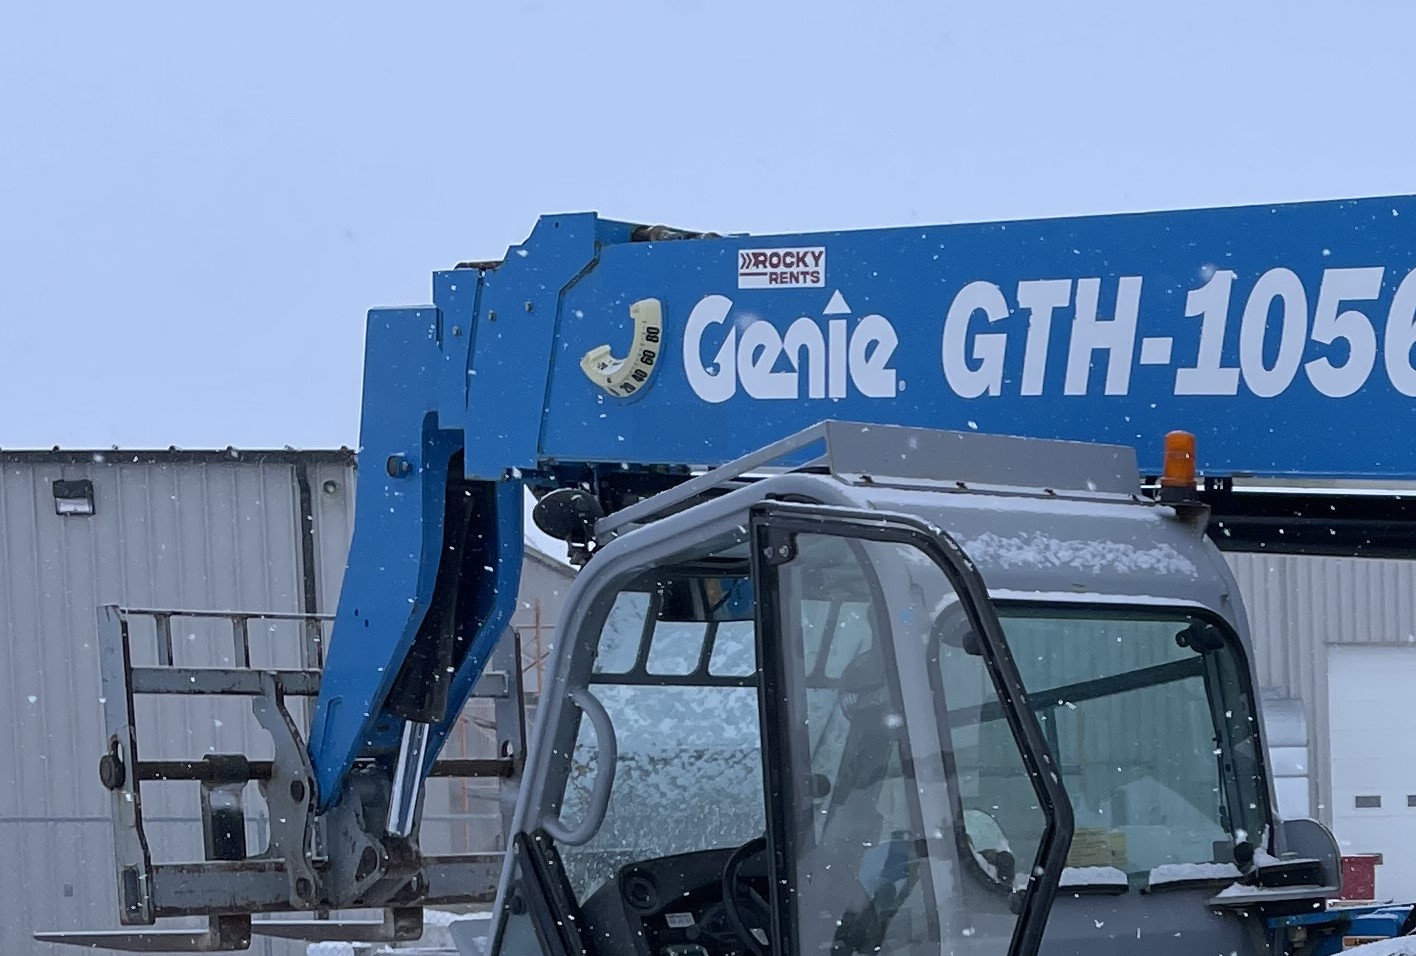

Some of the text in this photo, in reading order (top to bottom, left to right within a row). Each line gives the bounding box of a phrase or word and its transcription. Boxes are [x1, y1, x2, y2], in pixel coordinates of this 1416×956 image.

[752, 251, 823, 269] ROCKY
[769, 271, 820, 284] RENTS
[646, 326, 659, 343] 80
[683, 290, 899, 404] Genie
[640, 350, 655, 365] 60
[631, 368, 647, 382] 40
